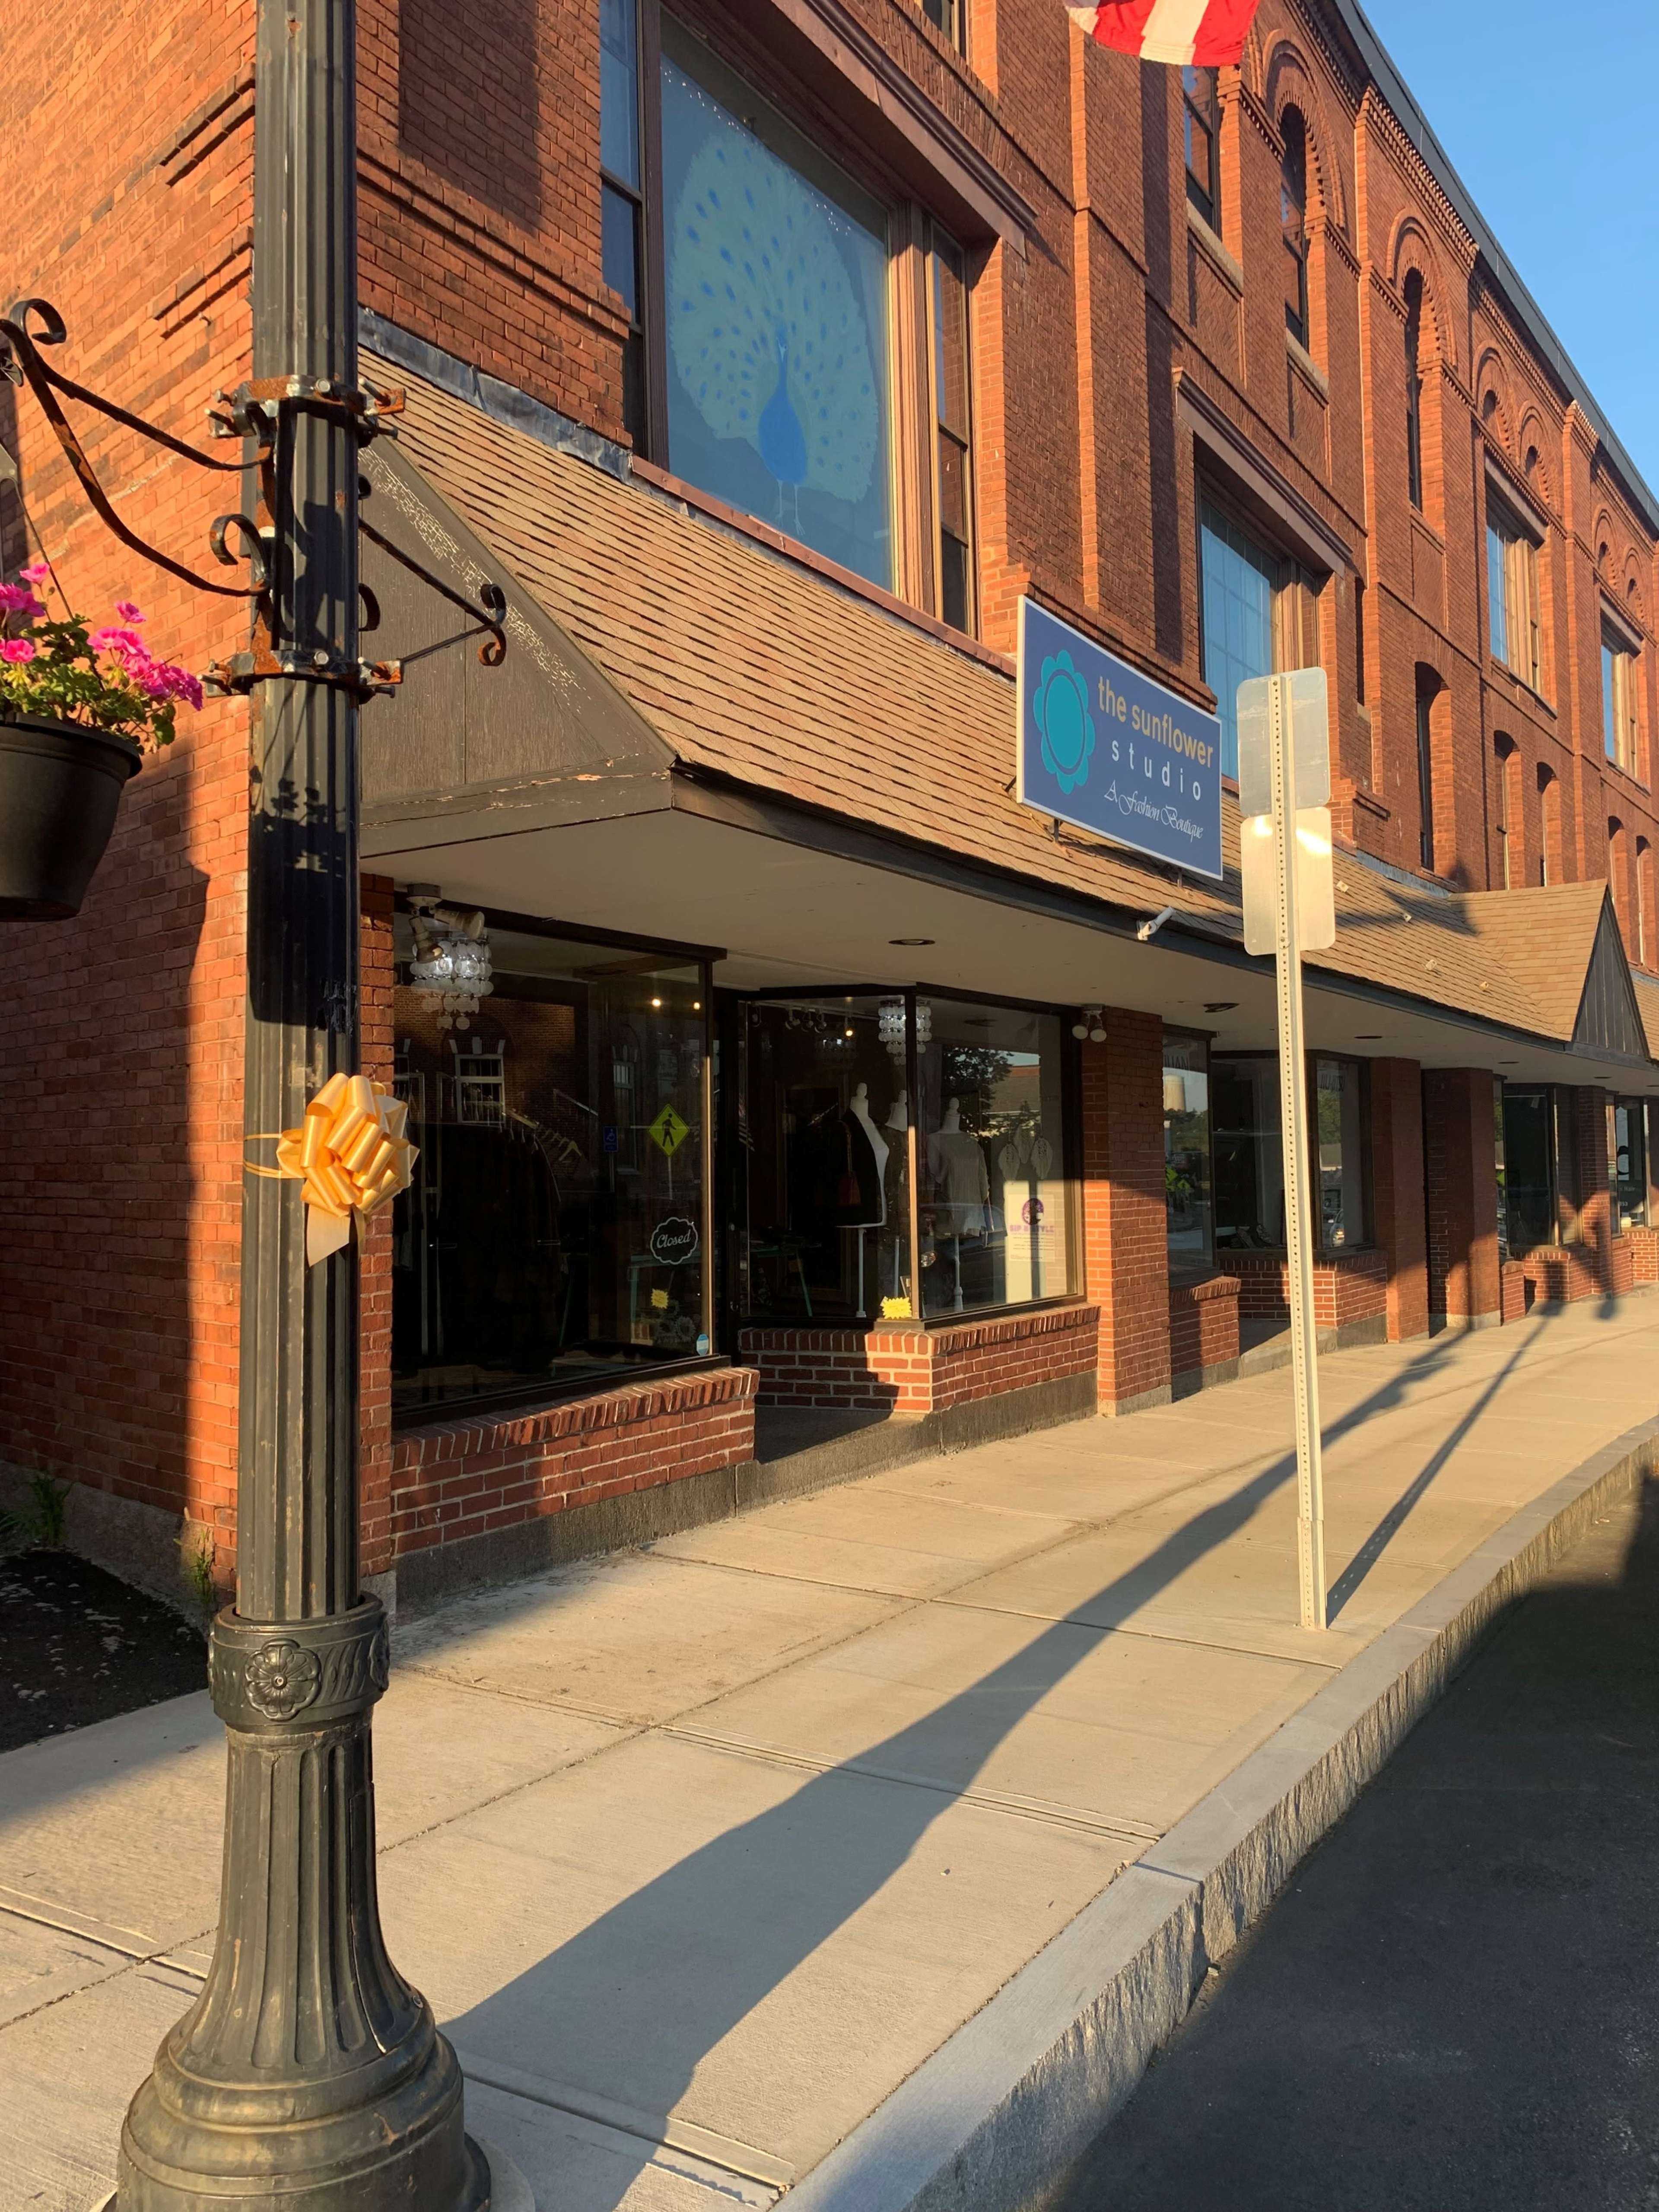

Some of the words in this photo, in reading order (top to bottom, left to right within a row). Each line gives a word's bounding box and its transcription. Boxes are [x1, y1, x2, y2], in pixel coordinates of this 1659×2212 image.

[1098, 676, 1127, 723] the
[1131, 705, 1213, 768] sunflower
[1112, 740, 1201, 801] studio
[1104, 779, 1118, 804] A
[1119, 790, 1160, 821] Fashion
[1160, 805, 1204, 843] Boutique
[657, 1229, 691, 1248] Closed
